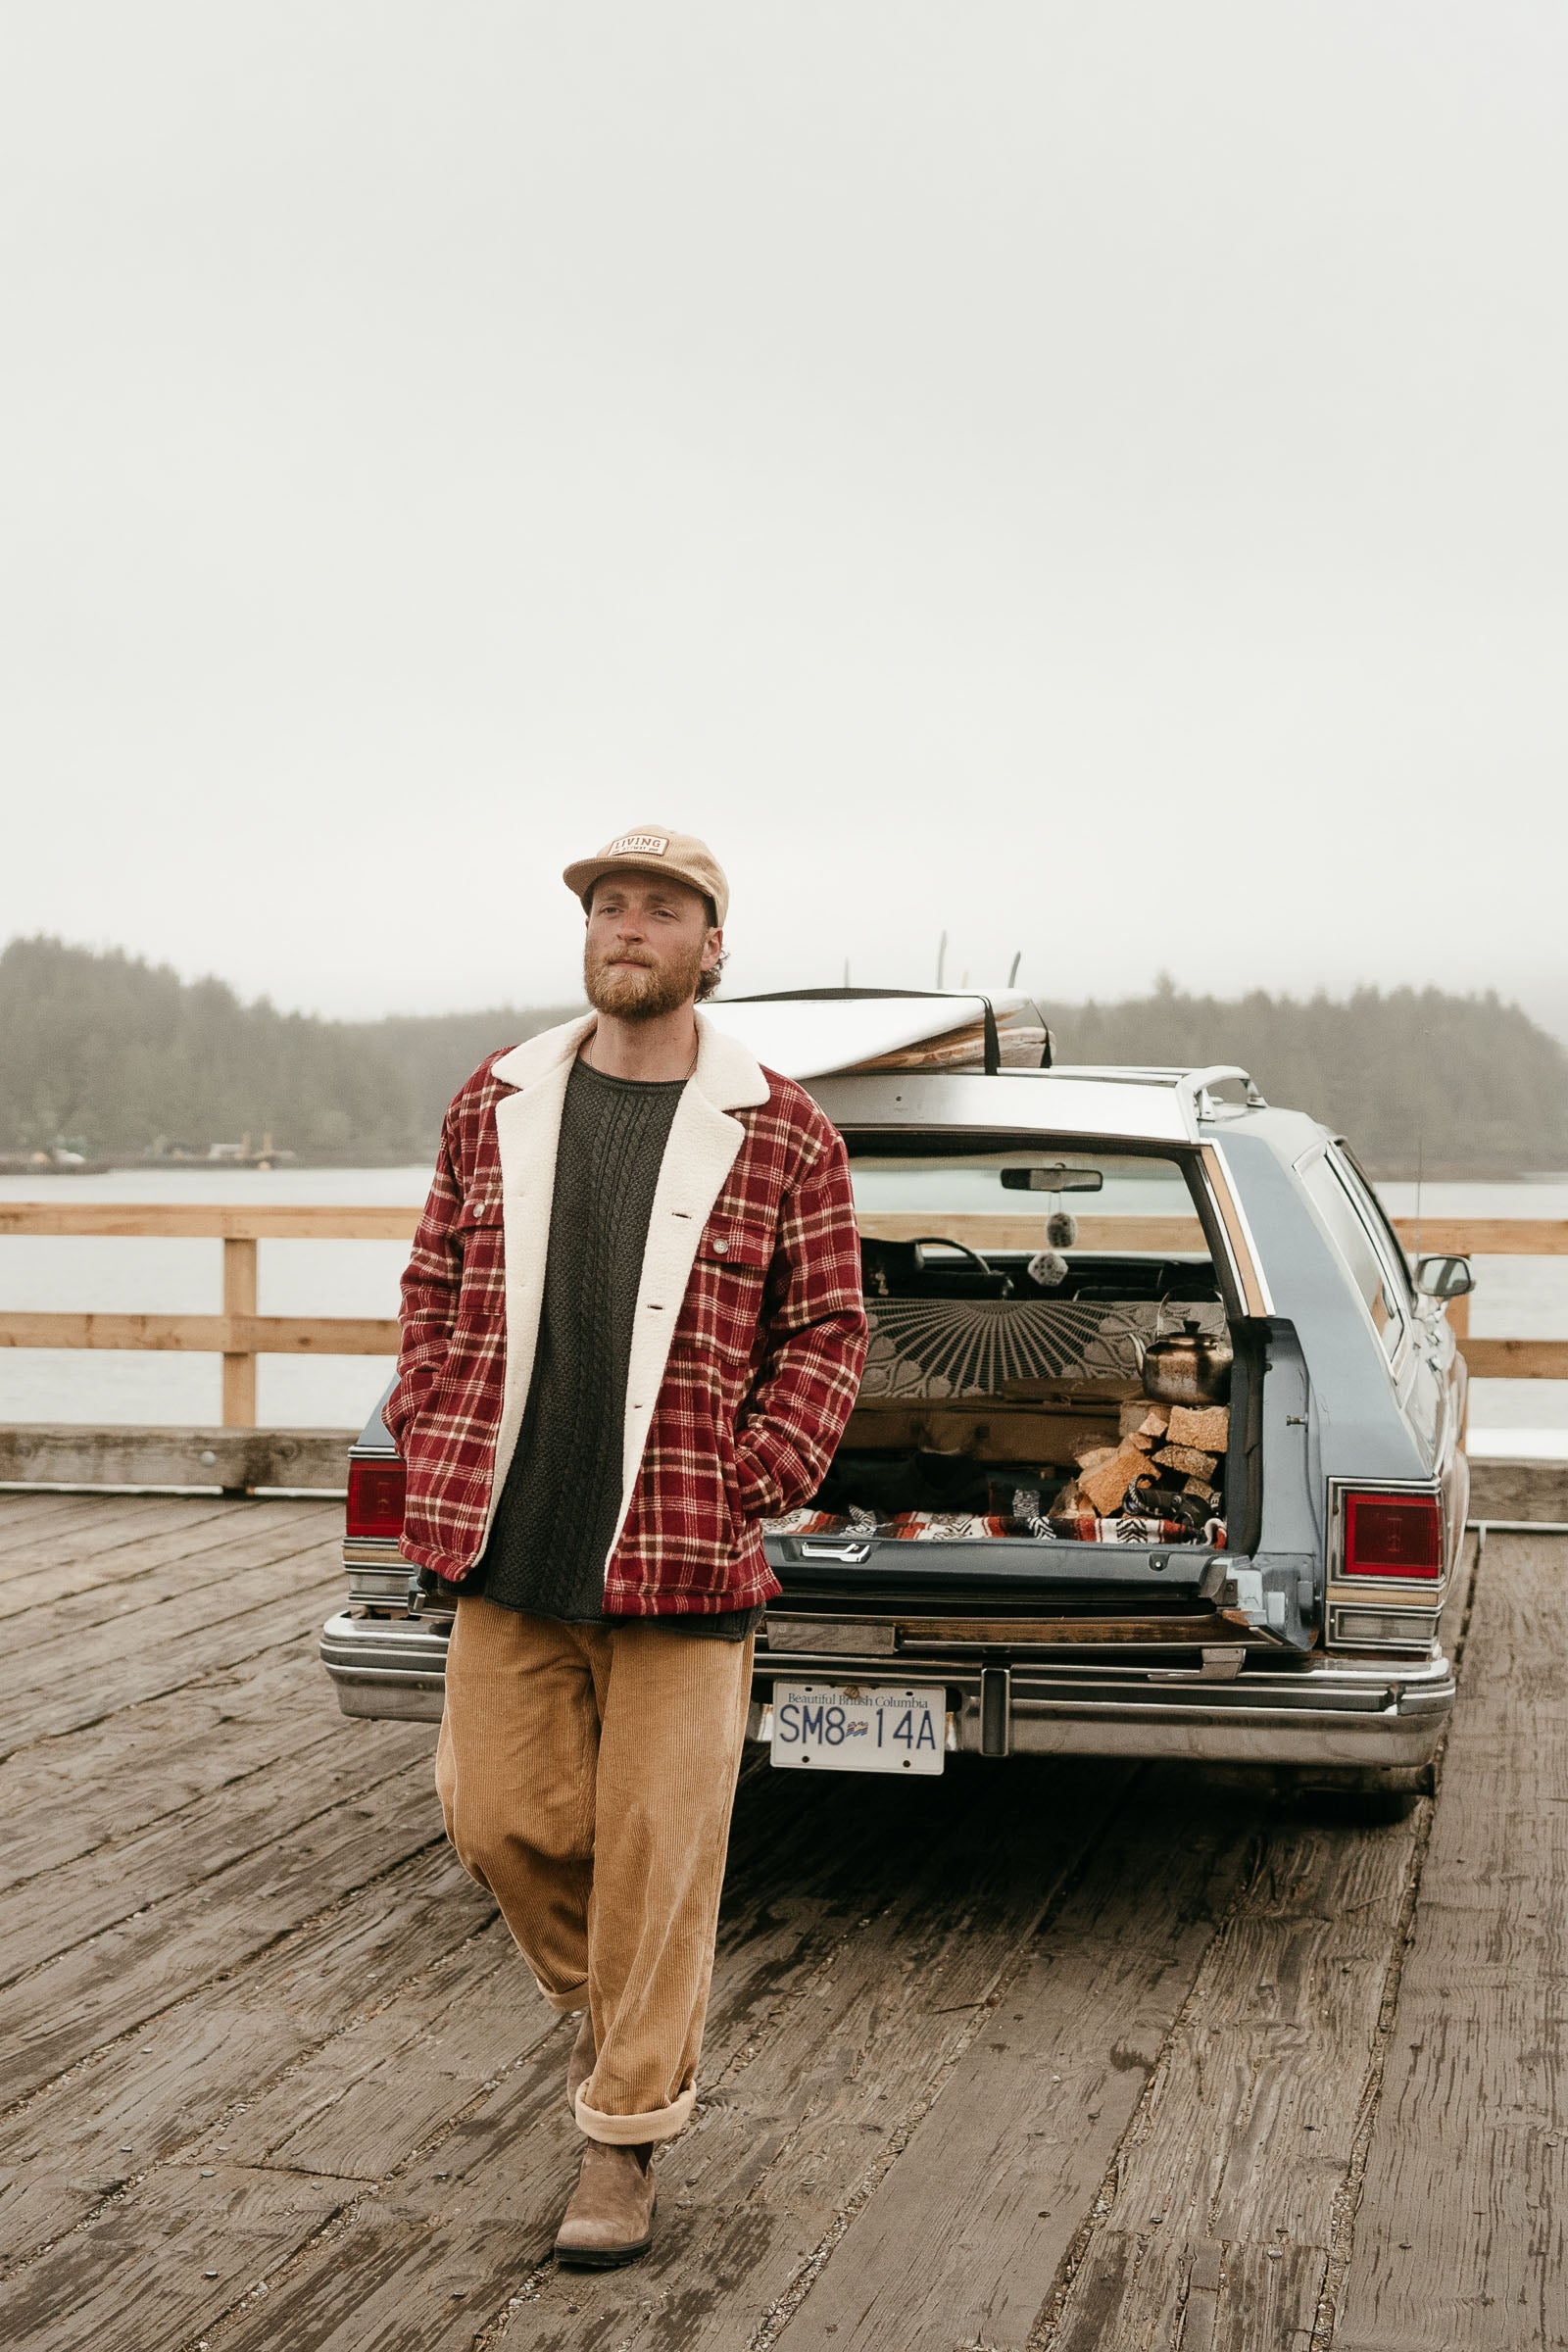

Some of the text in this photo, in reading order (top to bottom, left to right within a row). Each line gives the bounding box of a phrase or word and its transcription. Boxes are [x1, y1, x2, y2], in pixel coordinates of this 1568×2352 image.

[615, 837, 662, 849] LIVING
[788, 1692, 928, 1709] Beautiful British Columbia
[779, 1704, 936, 1749] SM8 14A
